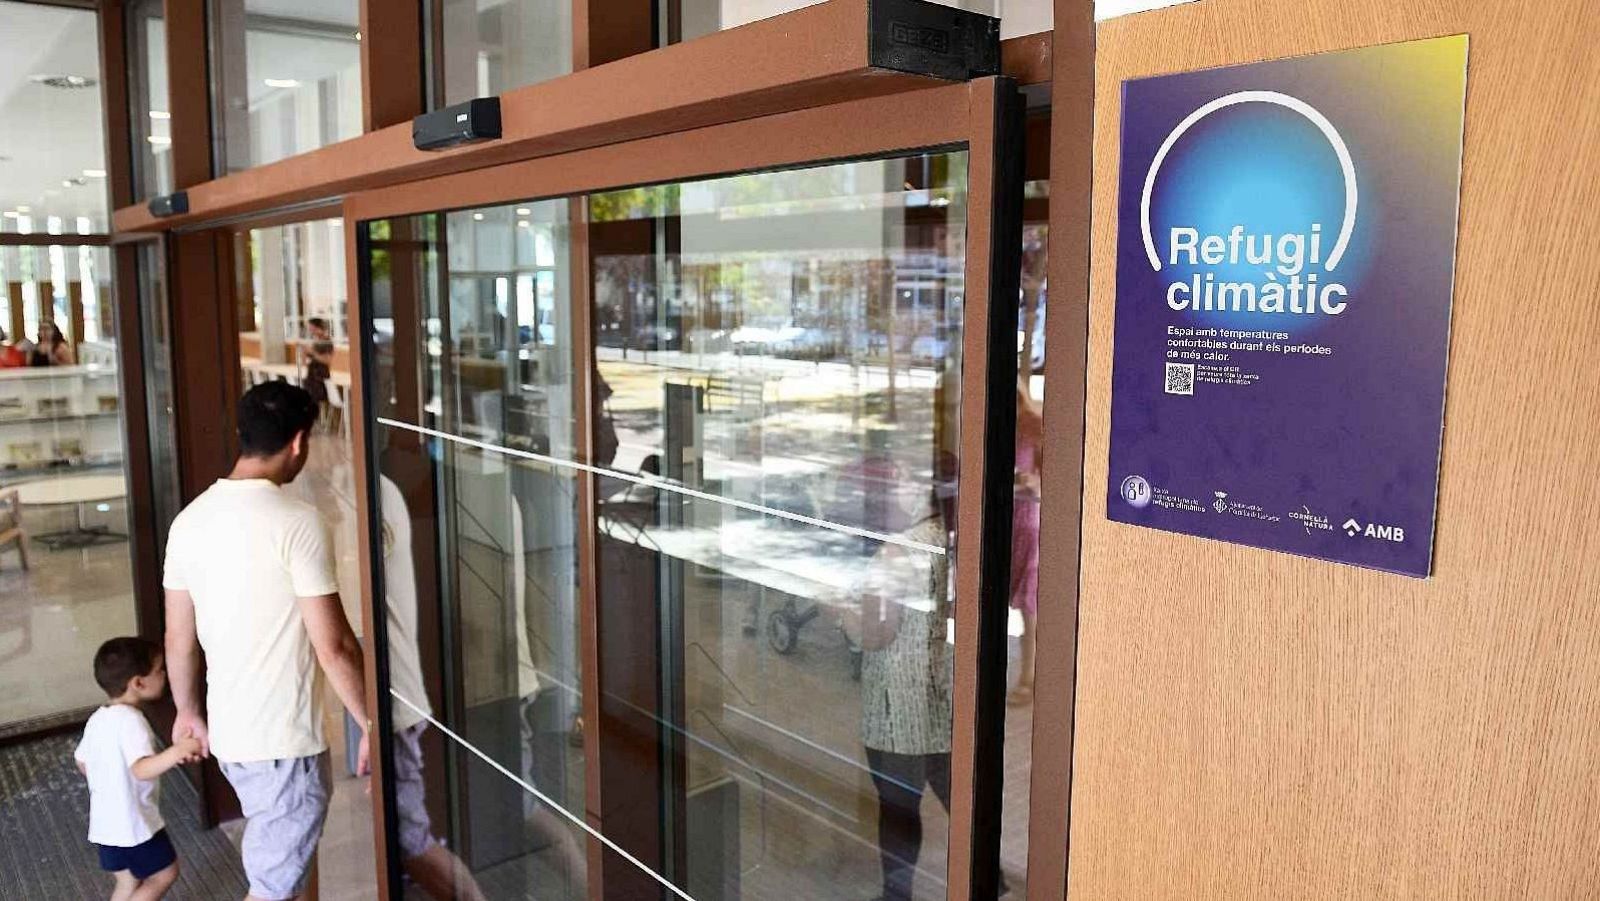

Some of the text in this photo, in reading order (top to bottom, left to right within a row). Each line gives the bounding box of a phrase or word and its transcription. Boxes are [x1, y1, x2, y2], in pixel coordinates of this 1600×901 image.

[1169, 223, 1321, 276] Refugi
[1166, 273, 1348, 315] climàtic
[1167, 325, 1289, 340] Espai amb temperatures
[1166, 349, 1230, 361] de més calor.
[1167, 338, 1332, 355] confortables durant els períodes
[1303, 521, 1334, 531] NATURA
[1364, 523, 1405, 542] AMB
